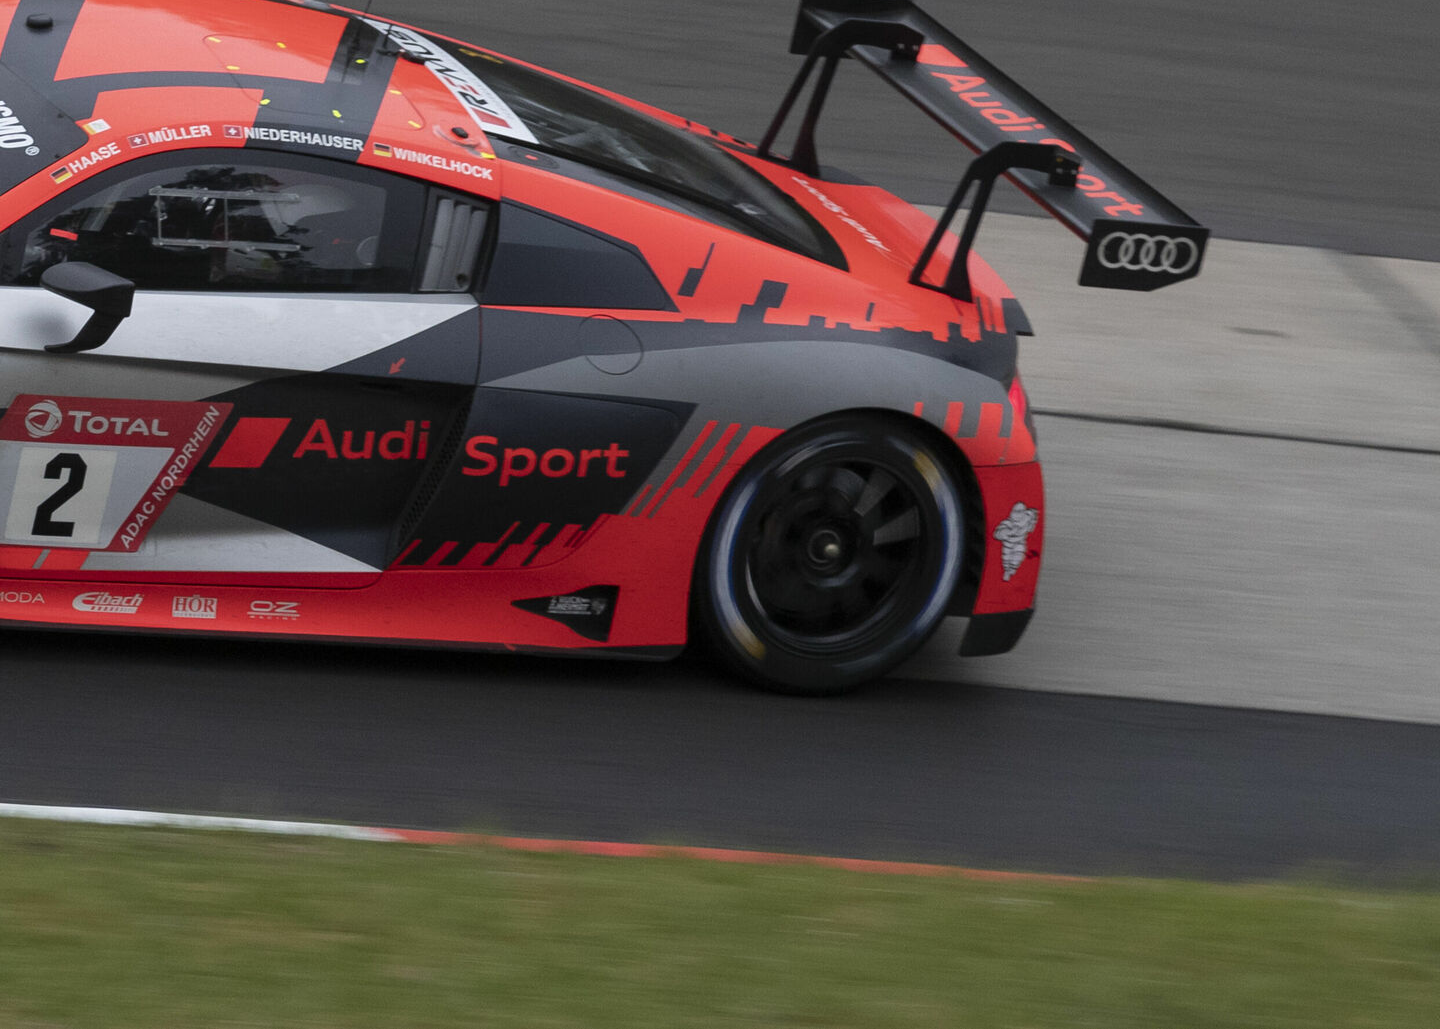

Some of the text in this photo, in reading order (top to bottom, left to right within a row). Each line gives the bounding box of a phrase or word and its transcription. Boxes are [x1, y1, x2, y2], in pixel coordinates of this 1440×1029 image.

[930, 71, 1046, 132] Audi
[67, 124, 493, 181] HAASE MÜLLER NIEDERHAUSER WINKELHOCK
[68, 410, 169, 437] TOTAL
[292, 418, 630, 487] Audi Sport
[31, 452, 88, 538] 2
[120, 405, 220, 550] ADAC NORDRHEIN
[71, 591, 144, 612] Eibach
